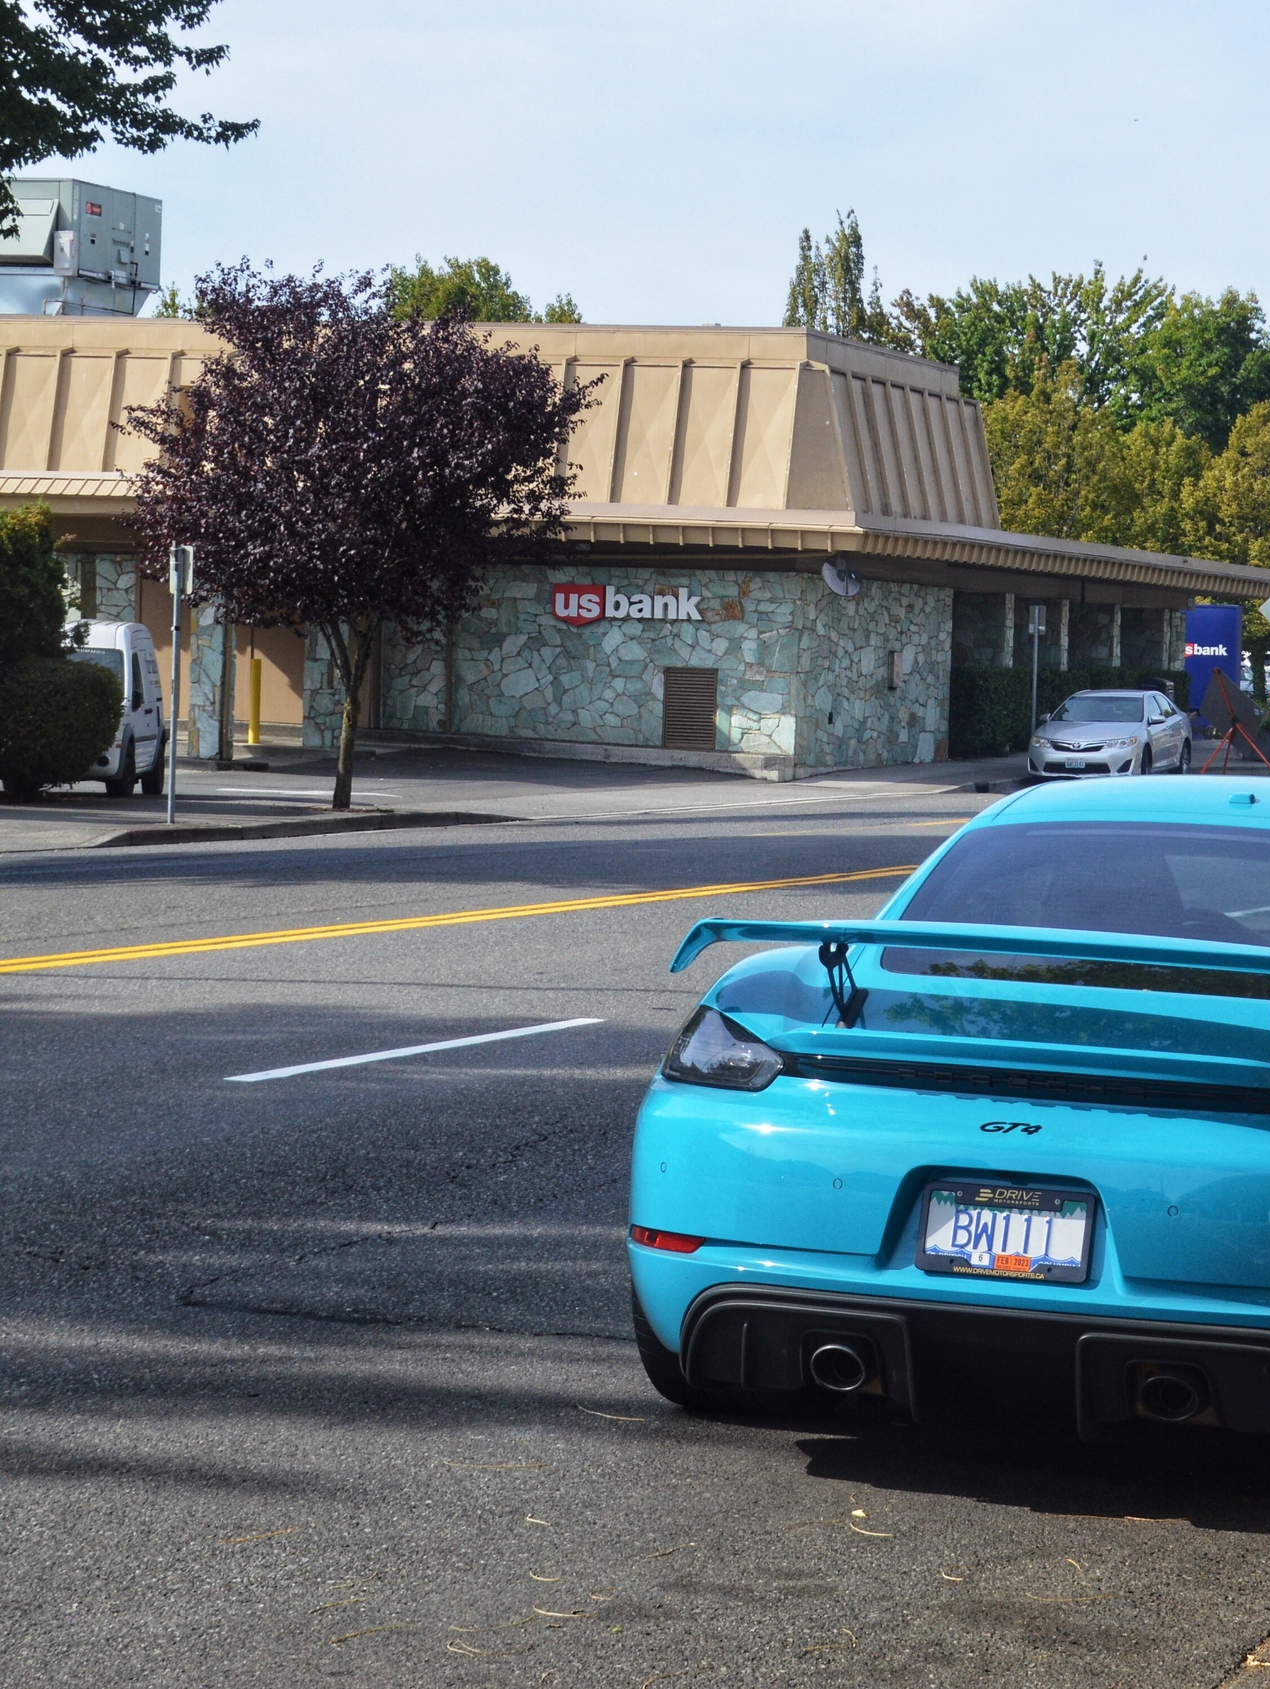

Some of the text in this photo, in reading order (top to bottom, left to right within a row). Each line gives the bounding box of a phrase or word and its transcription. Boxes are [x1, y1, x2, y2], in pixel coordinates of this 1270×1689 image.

[1185, 643, 1228, 656] sbank
[980, 1122, 1042, 1136] GT4
[994, 1188, 1042, 1202] DRIVE
[993, 1198, 1040, 1207] MOTORSPORTS
[951, 1209, 1053, 1255] BW111
[996, 1256, 1029, 1267] FEB 2023
[953, 1266, 1045, 1280] WWW.DRIVEMOTORSPORTS.CA
